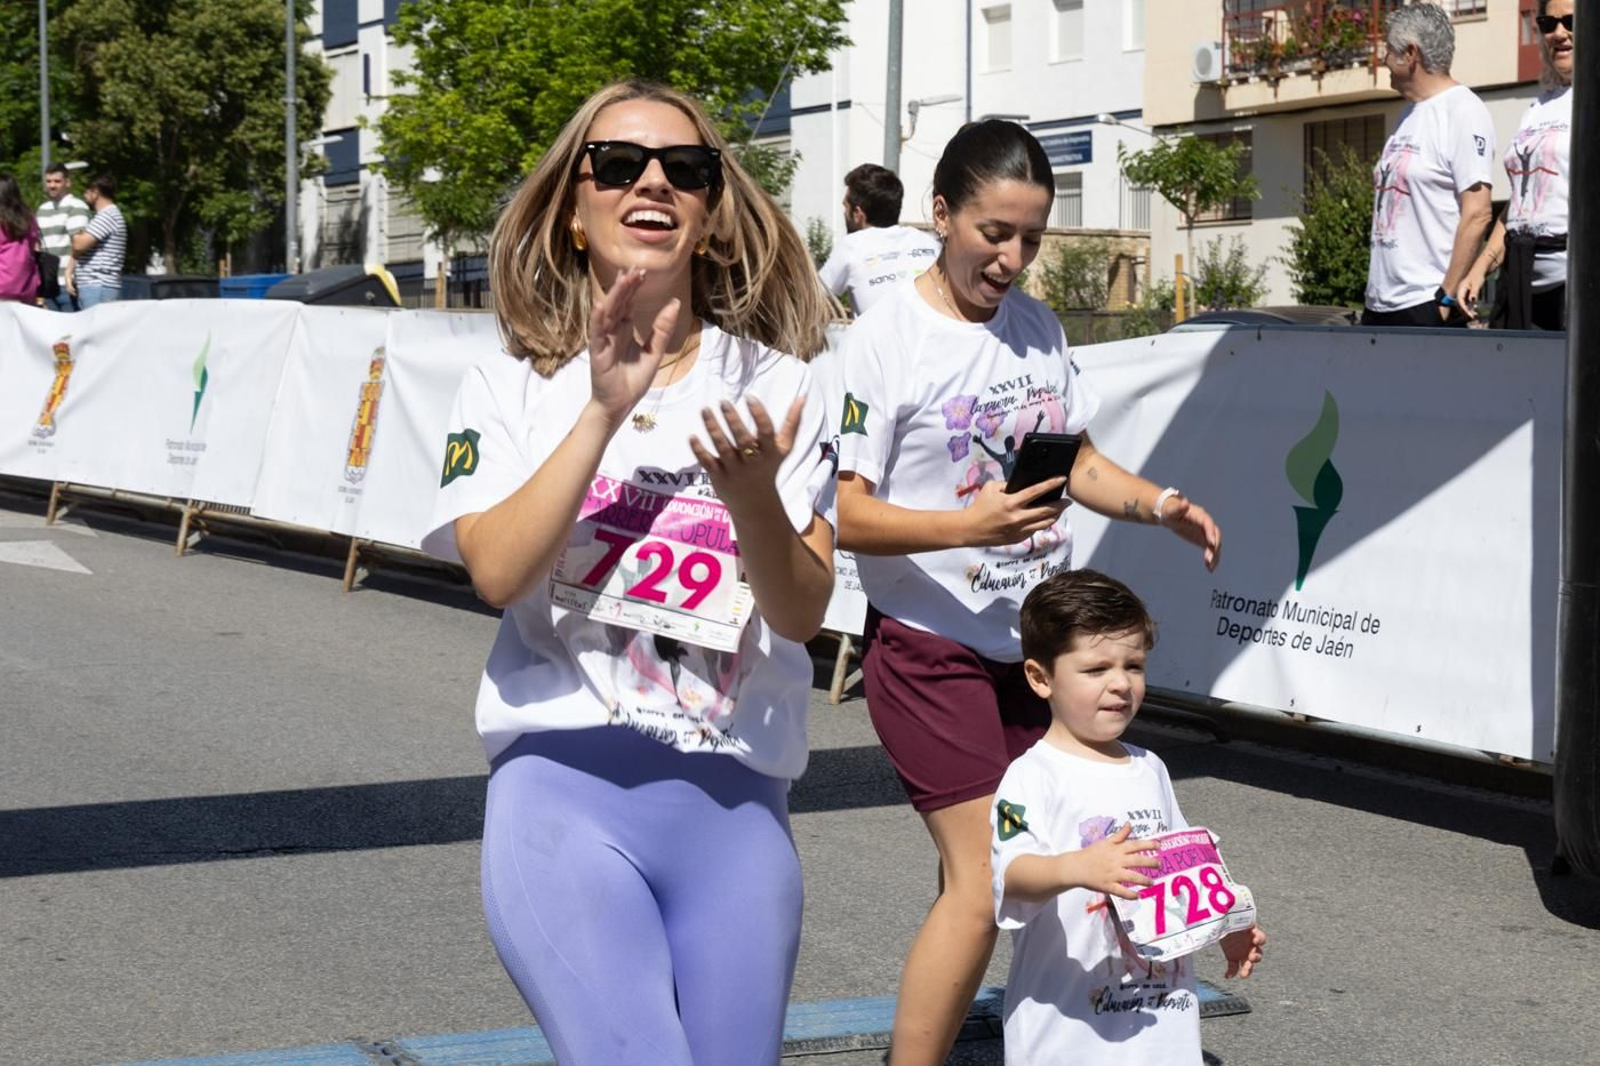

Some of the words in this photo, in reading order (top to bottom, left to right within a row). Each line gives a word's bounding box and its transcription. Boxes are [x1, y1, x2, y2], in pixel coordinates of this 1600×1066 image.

[868, 273, 897, 287] sano
[988, 374, 1033, 395] XXVII
[667, 521, 740, 554] POPULA
[580, 529, 723, 611] 729
[1210, 588, 1279, 619] Patronato
[1281, 600, 1358, 633] Municipal
[1360, 612, 1381, 635] de
[1216, 616, 1288, 647] Deportes
[1290, 630, 1312, 651] de
[1315, 634, 1354, 659] Jaén
[1126, 809, 1162, 820] XXVII
[1138, 866, 1236, 936] 728
